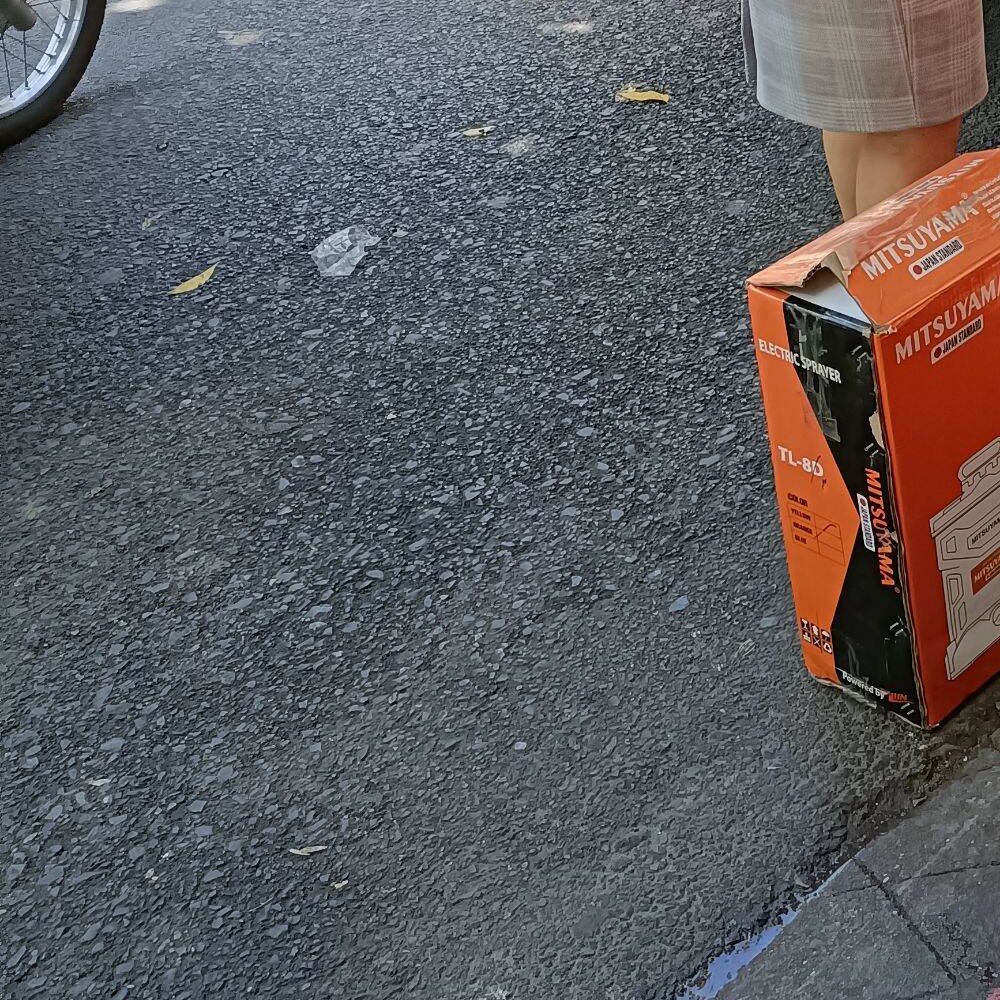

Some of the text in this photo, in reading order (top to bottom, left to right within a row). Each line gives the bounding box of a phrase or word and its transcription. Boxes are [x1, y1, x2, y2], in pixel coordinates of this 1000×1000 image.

[860, 199, 980, 281] MITSUYAMA
[921, 239, 964, 272] JAPAN STANDARD
[943, 318, 982, 354] JAPAN STANDARD
[758, 338, 842, 383] ELECTRIC SPRAYER
[787, 492, 808, 507] COLOR
[865, 467, 895, 586] MITSUYAMA
[842, 670, 874, 694] Powered
[873, 686, 885, 700] by
